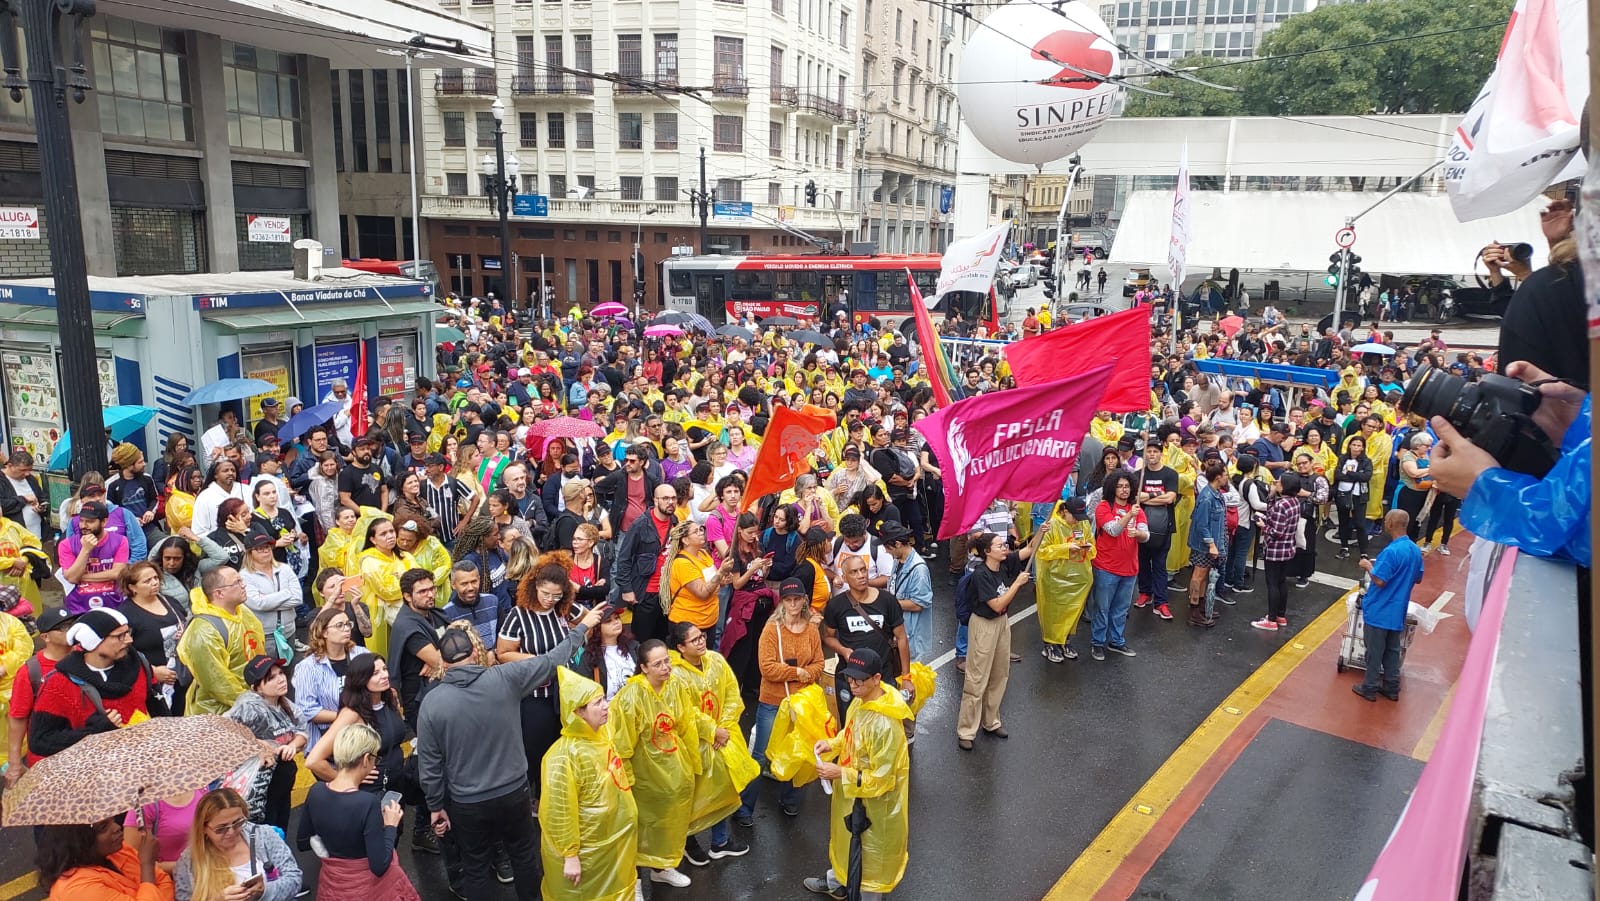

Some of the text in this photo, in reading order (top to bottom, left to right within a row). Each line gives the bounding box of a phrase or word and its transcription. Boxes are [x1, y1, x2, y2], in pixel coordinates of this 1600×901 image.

[264, 220, 286, 229] VENDE
[291, 289, 366, 301] Banca Viaduto do Chá
[130, 298, 140, 308] 5G
[210, 297, 228, 308] TIM
[970, 437, 1078, 476] REVOLUCIONÁRIA
